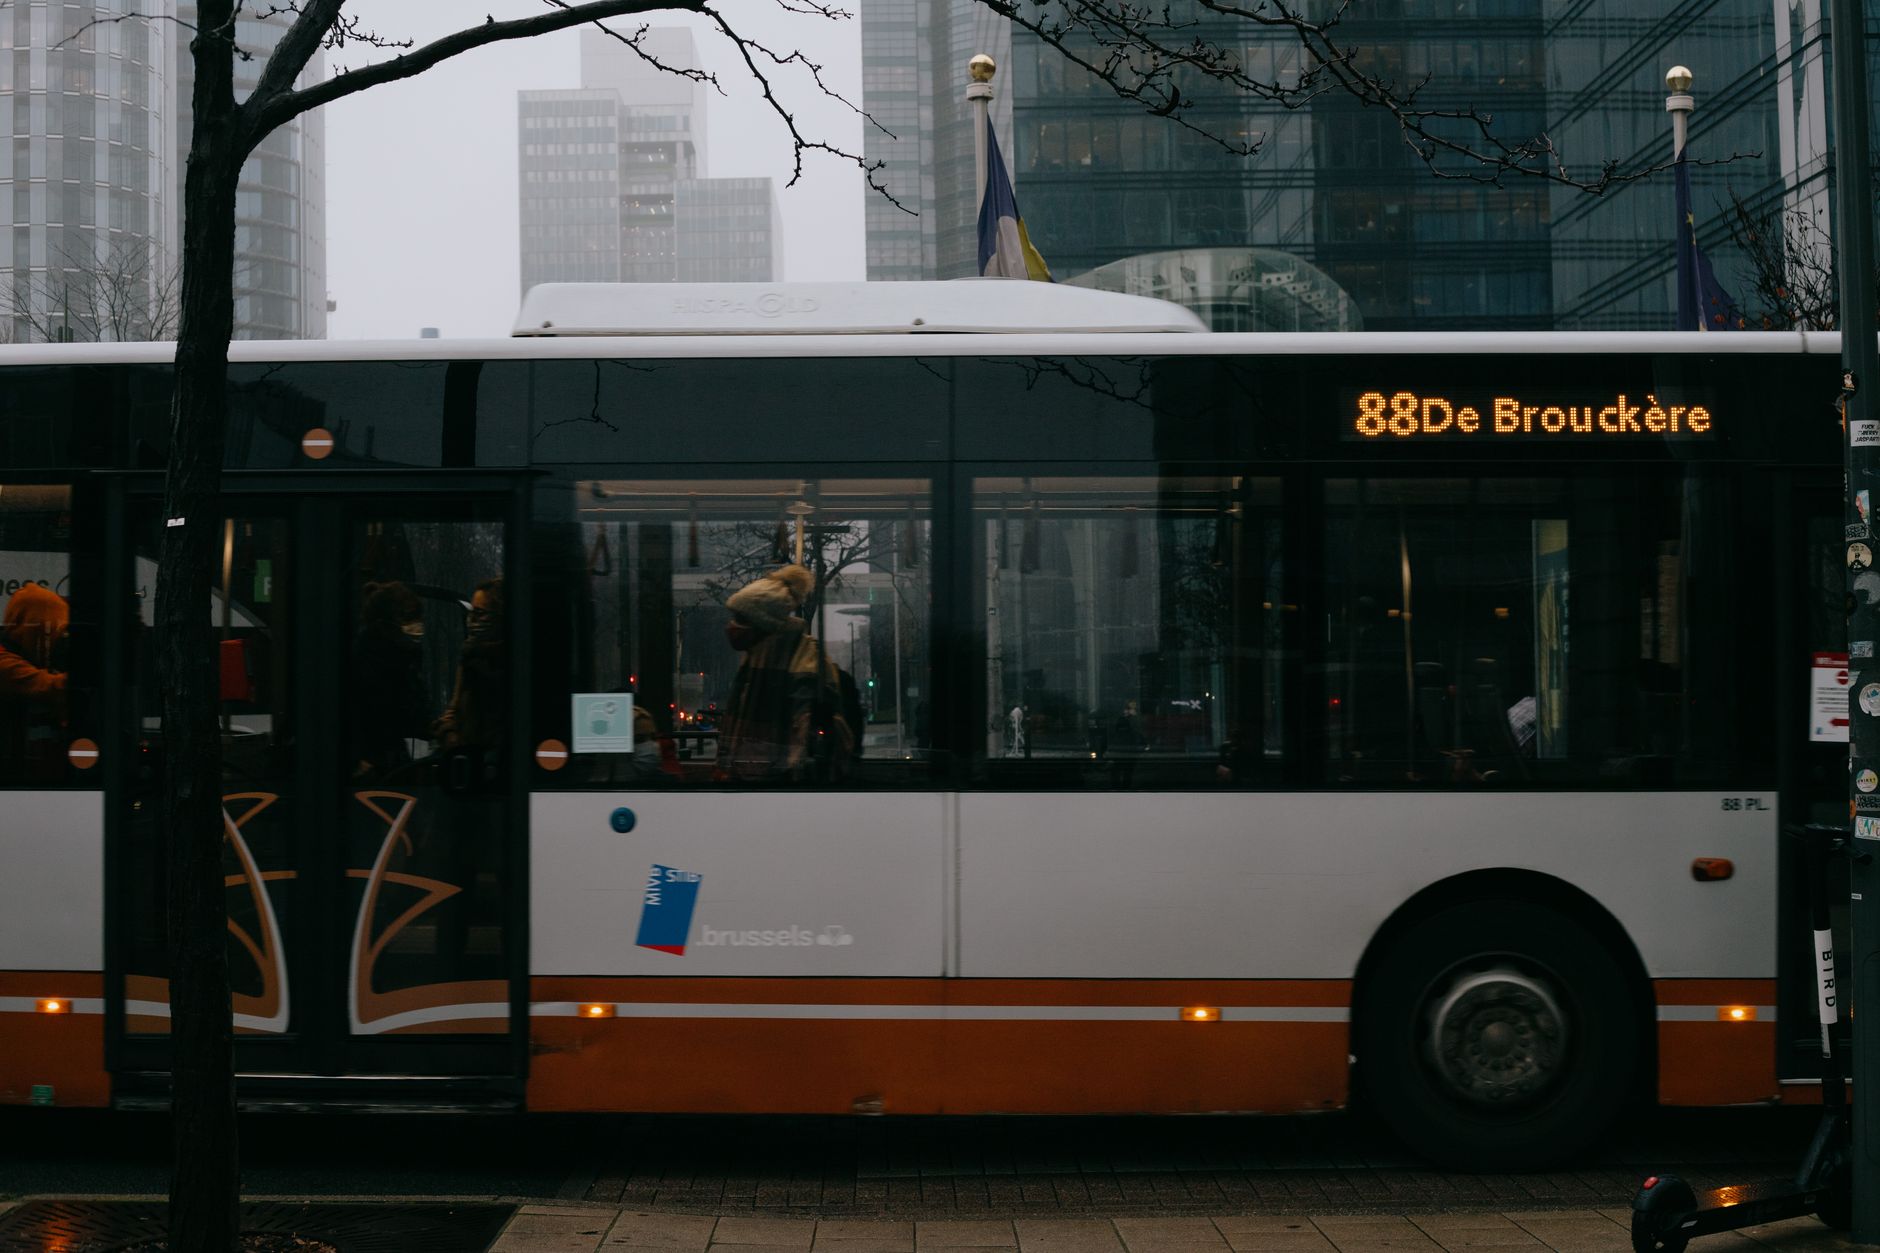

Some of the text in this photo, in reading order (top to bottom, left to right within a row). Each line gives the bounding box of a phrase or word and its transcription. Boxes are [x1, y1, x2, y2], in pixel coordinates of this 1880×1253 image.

[1355, 392, 1711, 436] 88 De Brouckère
[644, 867, 663, 906] MIVB
[1822, 950, 1836, 1008] BIRD
